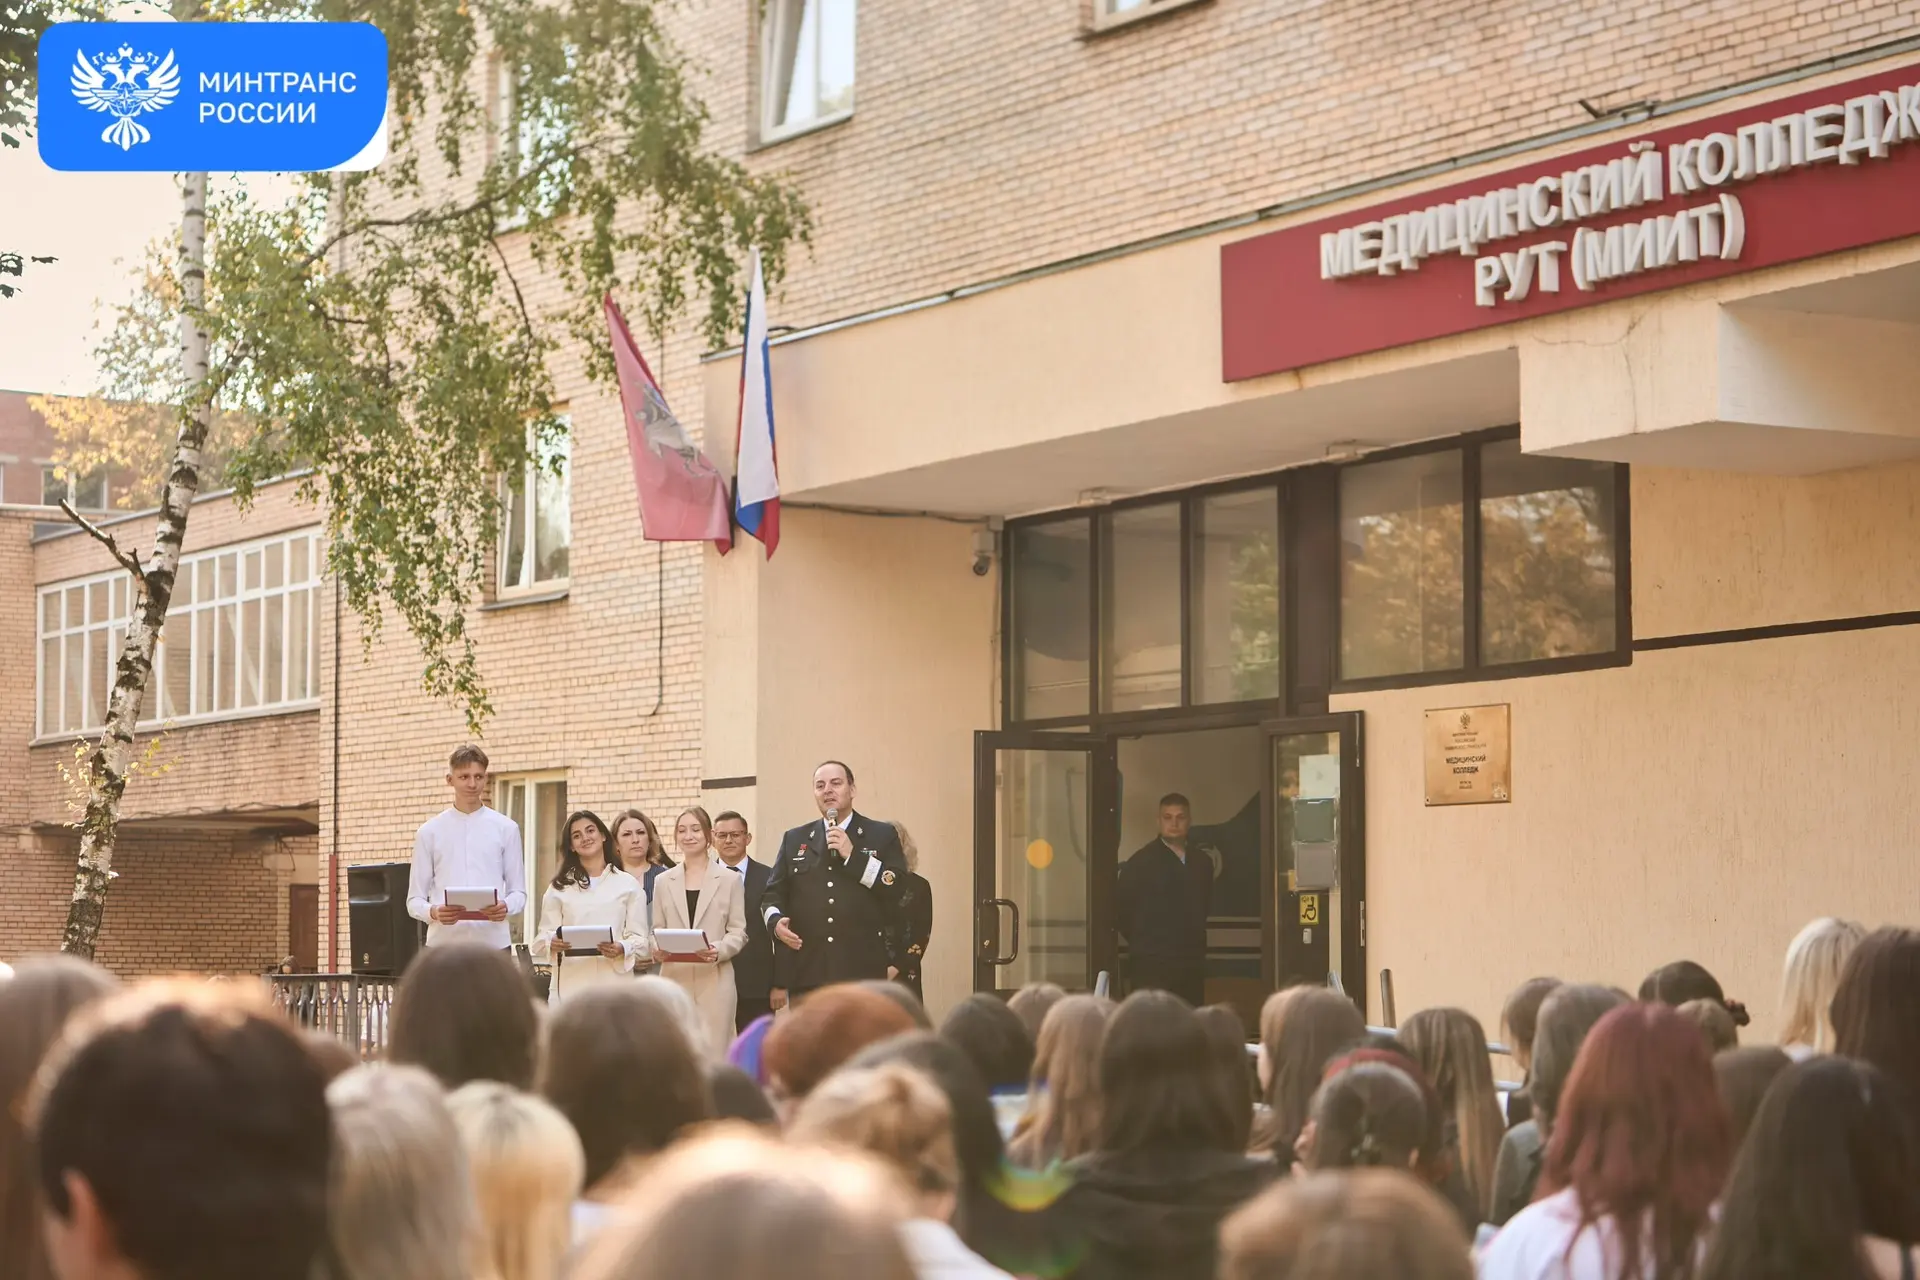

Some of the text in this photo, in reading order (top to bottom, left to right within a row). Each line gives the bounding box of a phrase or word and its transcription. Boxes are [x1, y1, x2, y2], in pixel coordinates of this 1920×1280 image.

[1320, 82, 1920, 280] МЕДИЦИНСКИЙ КОЛЛЕДЖ
[1475, 193, 1745, 306] РУТ (МИИТ)
